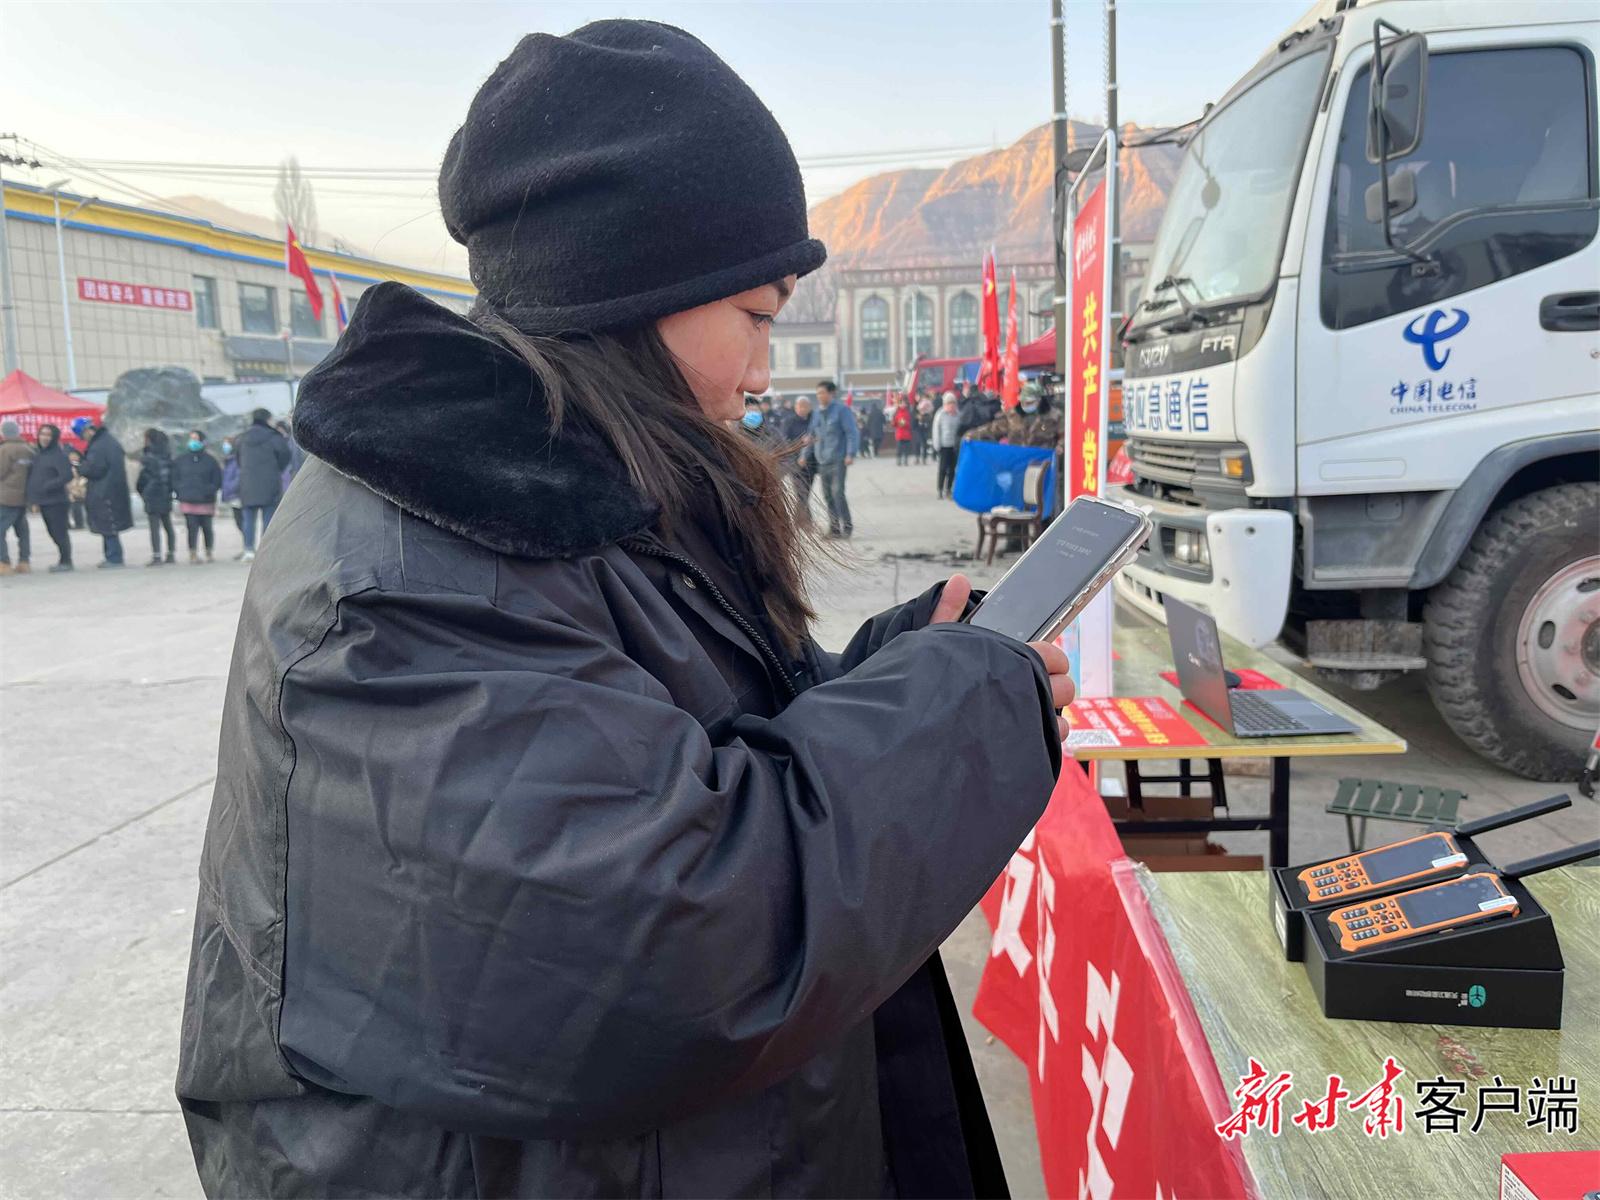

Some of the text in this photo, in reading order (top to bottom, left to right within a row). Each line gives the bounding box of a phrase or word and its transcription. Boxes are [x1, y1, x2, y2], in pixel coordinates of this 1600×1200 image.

[1201, 335, 1236, 354] FTR
[1082, 291, 1098, 492] 共产党
[1391, 378, 1476, 404] 中国电信
[1390, 402, 1478, 415] CHINA TELECOM
